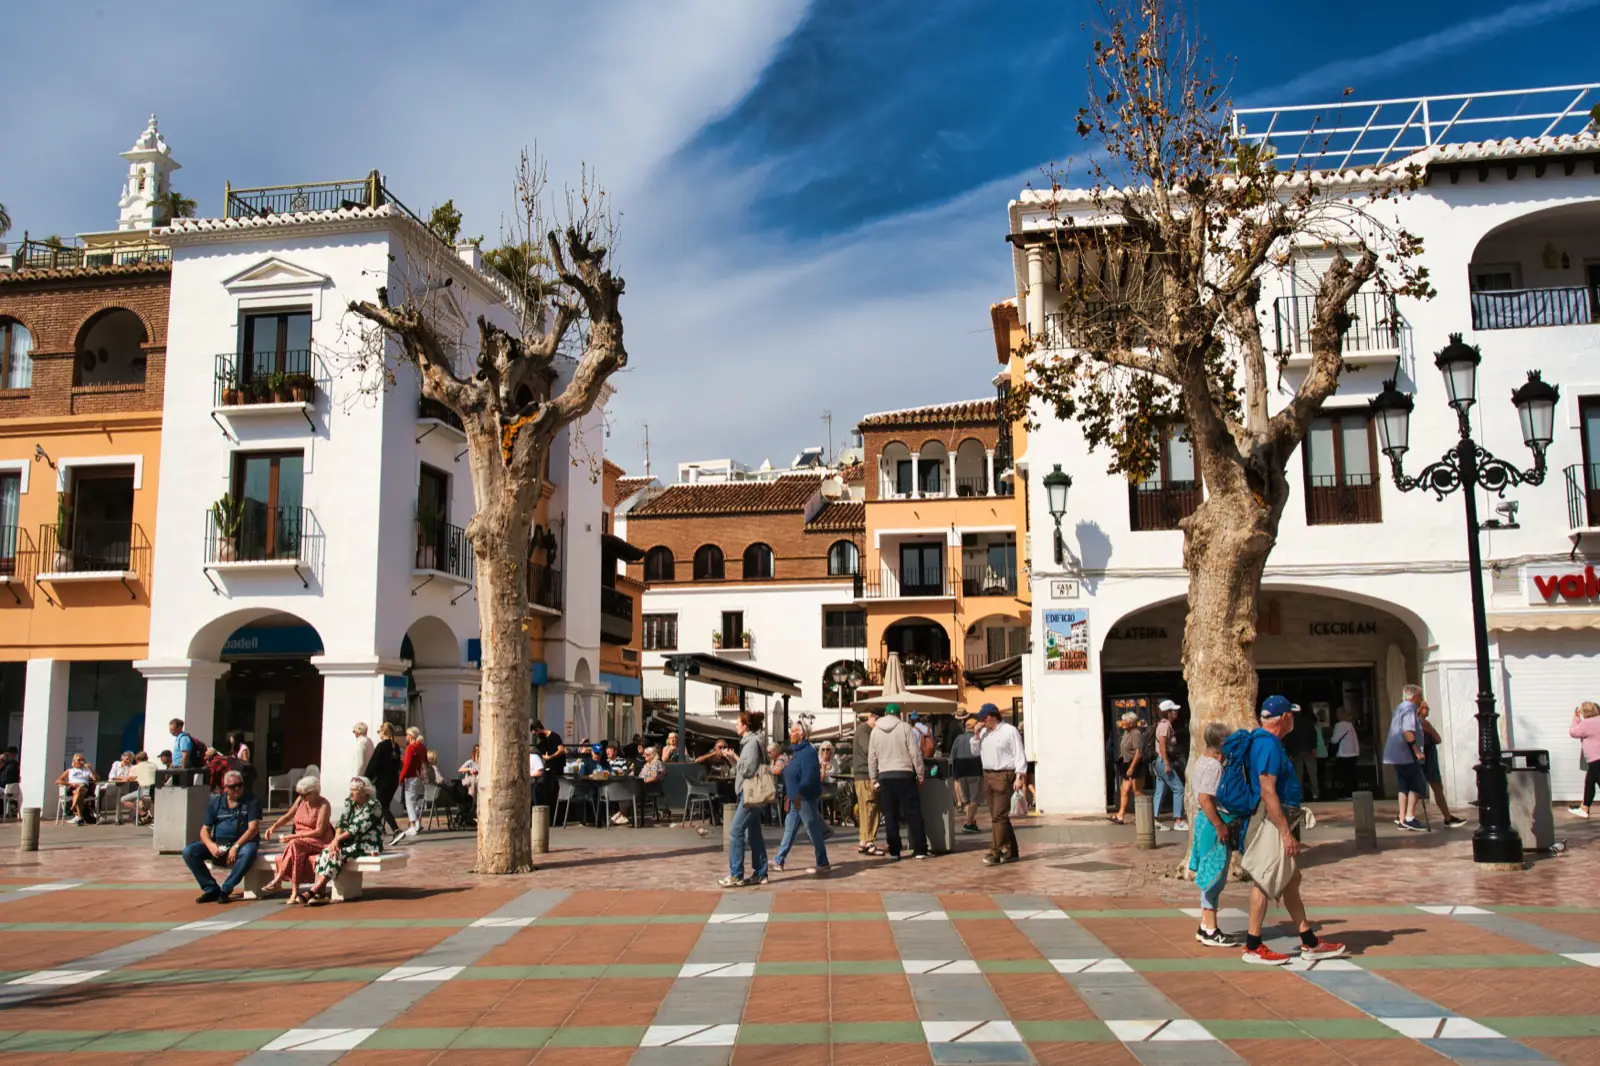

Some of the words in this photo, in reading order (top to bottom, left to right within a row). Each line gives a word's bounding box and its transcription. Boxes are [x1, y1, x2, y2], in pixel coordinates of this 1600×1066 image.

[1533, 565, 1600, 601] val
[1045, 613, 1076, 623] EDIFICIO
[1309, 621, 1378, 636] ICECREAM
[1047, 660, 1057, 670] DE
[1060, 660, 1088, 670] EUROPA
